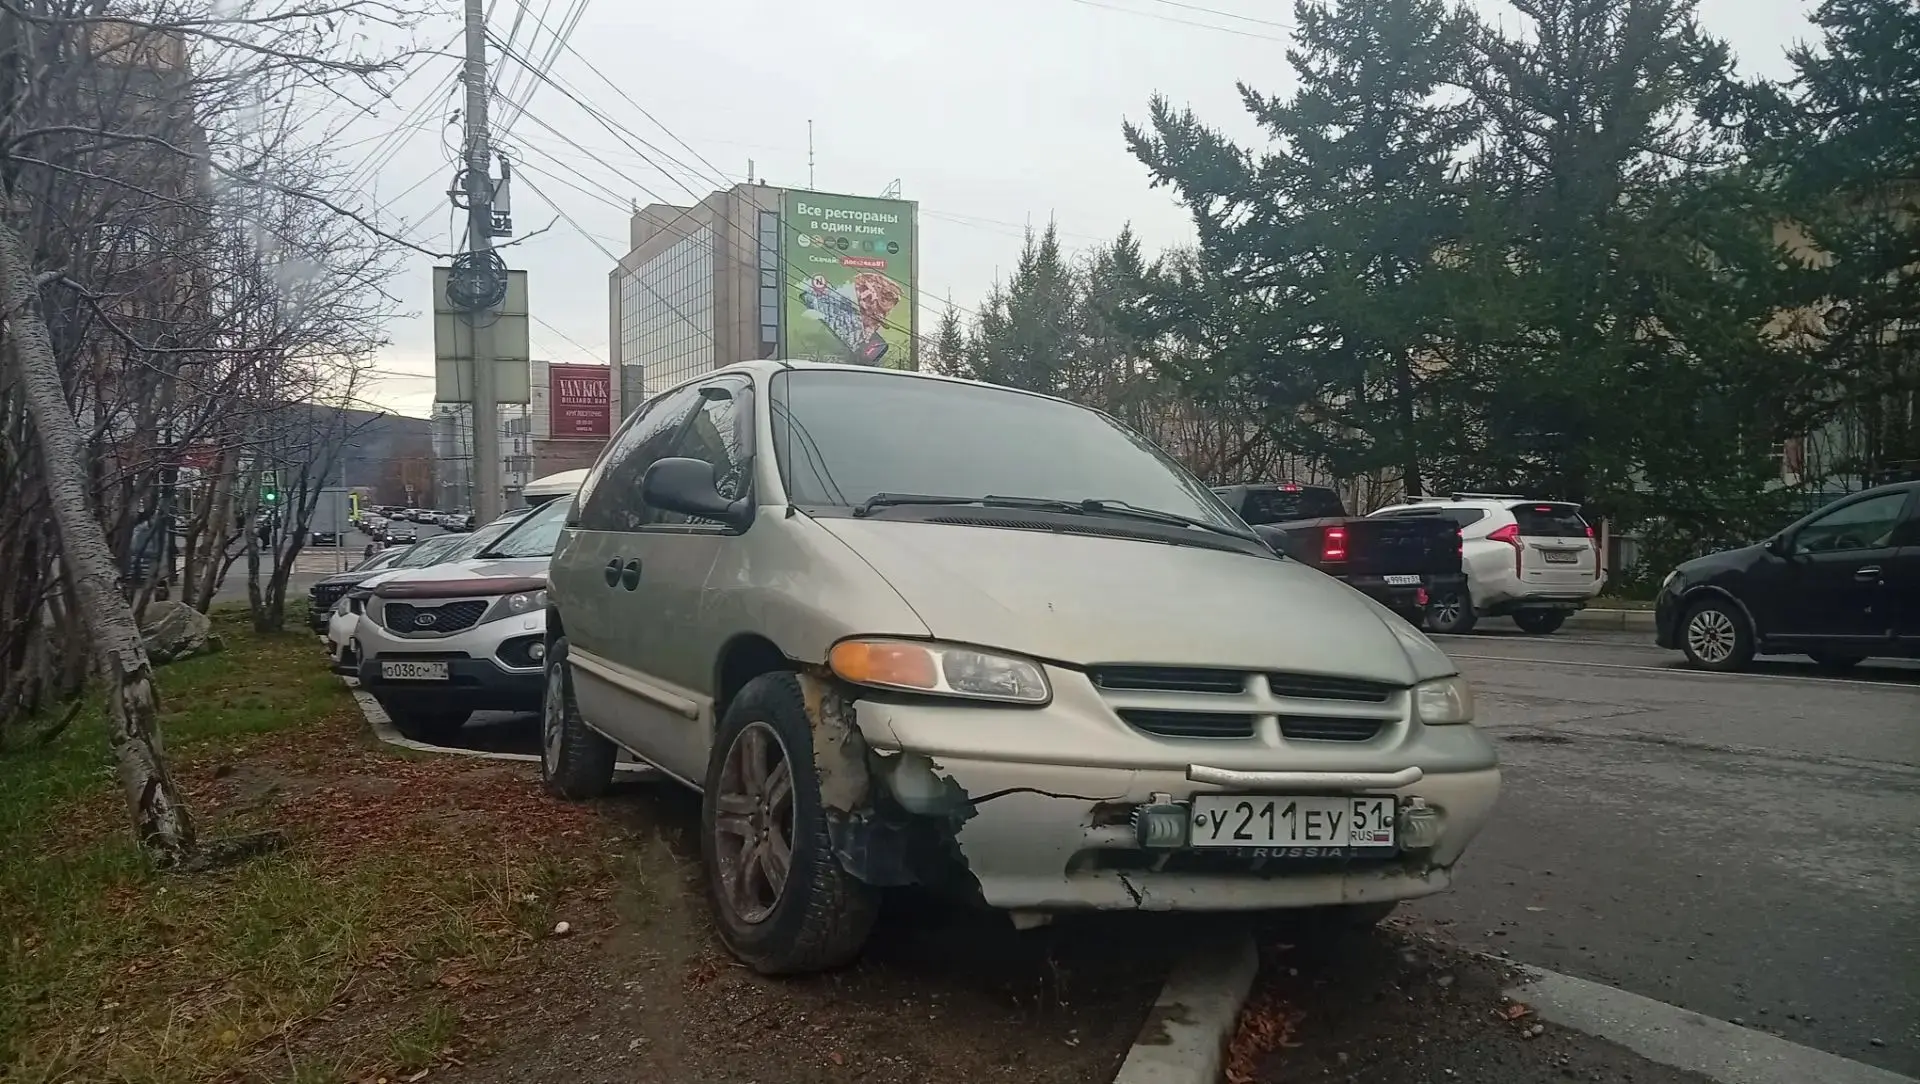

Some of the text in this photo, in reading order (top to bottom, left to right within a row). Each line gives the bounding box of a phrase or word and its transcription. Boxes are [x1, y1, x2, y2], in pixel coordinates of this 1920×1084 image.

[797, 202, 899, 224] Все рестораны
[810, 221, 885, 235] в один клик
[560, 379, 580, 397] VAN
[1210, 801, 1383, 840] У211ЕУ 51
[1351, 830, 1373, 841] RUS
[1252, 847, 1343, 857] RUSSIA
